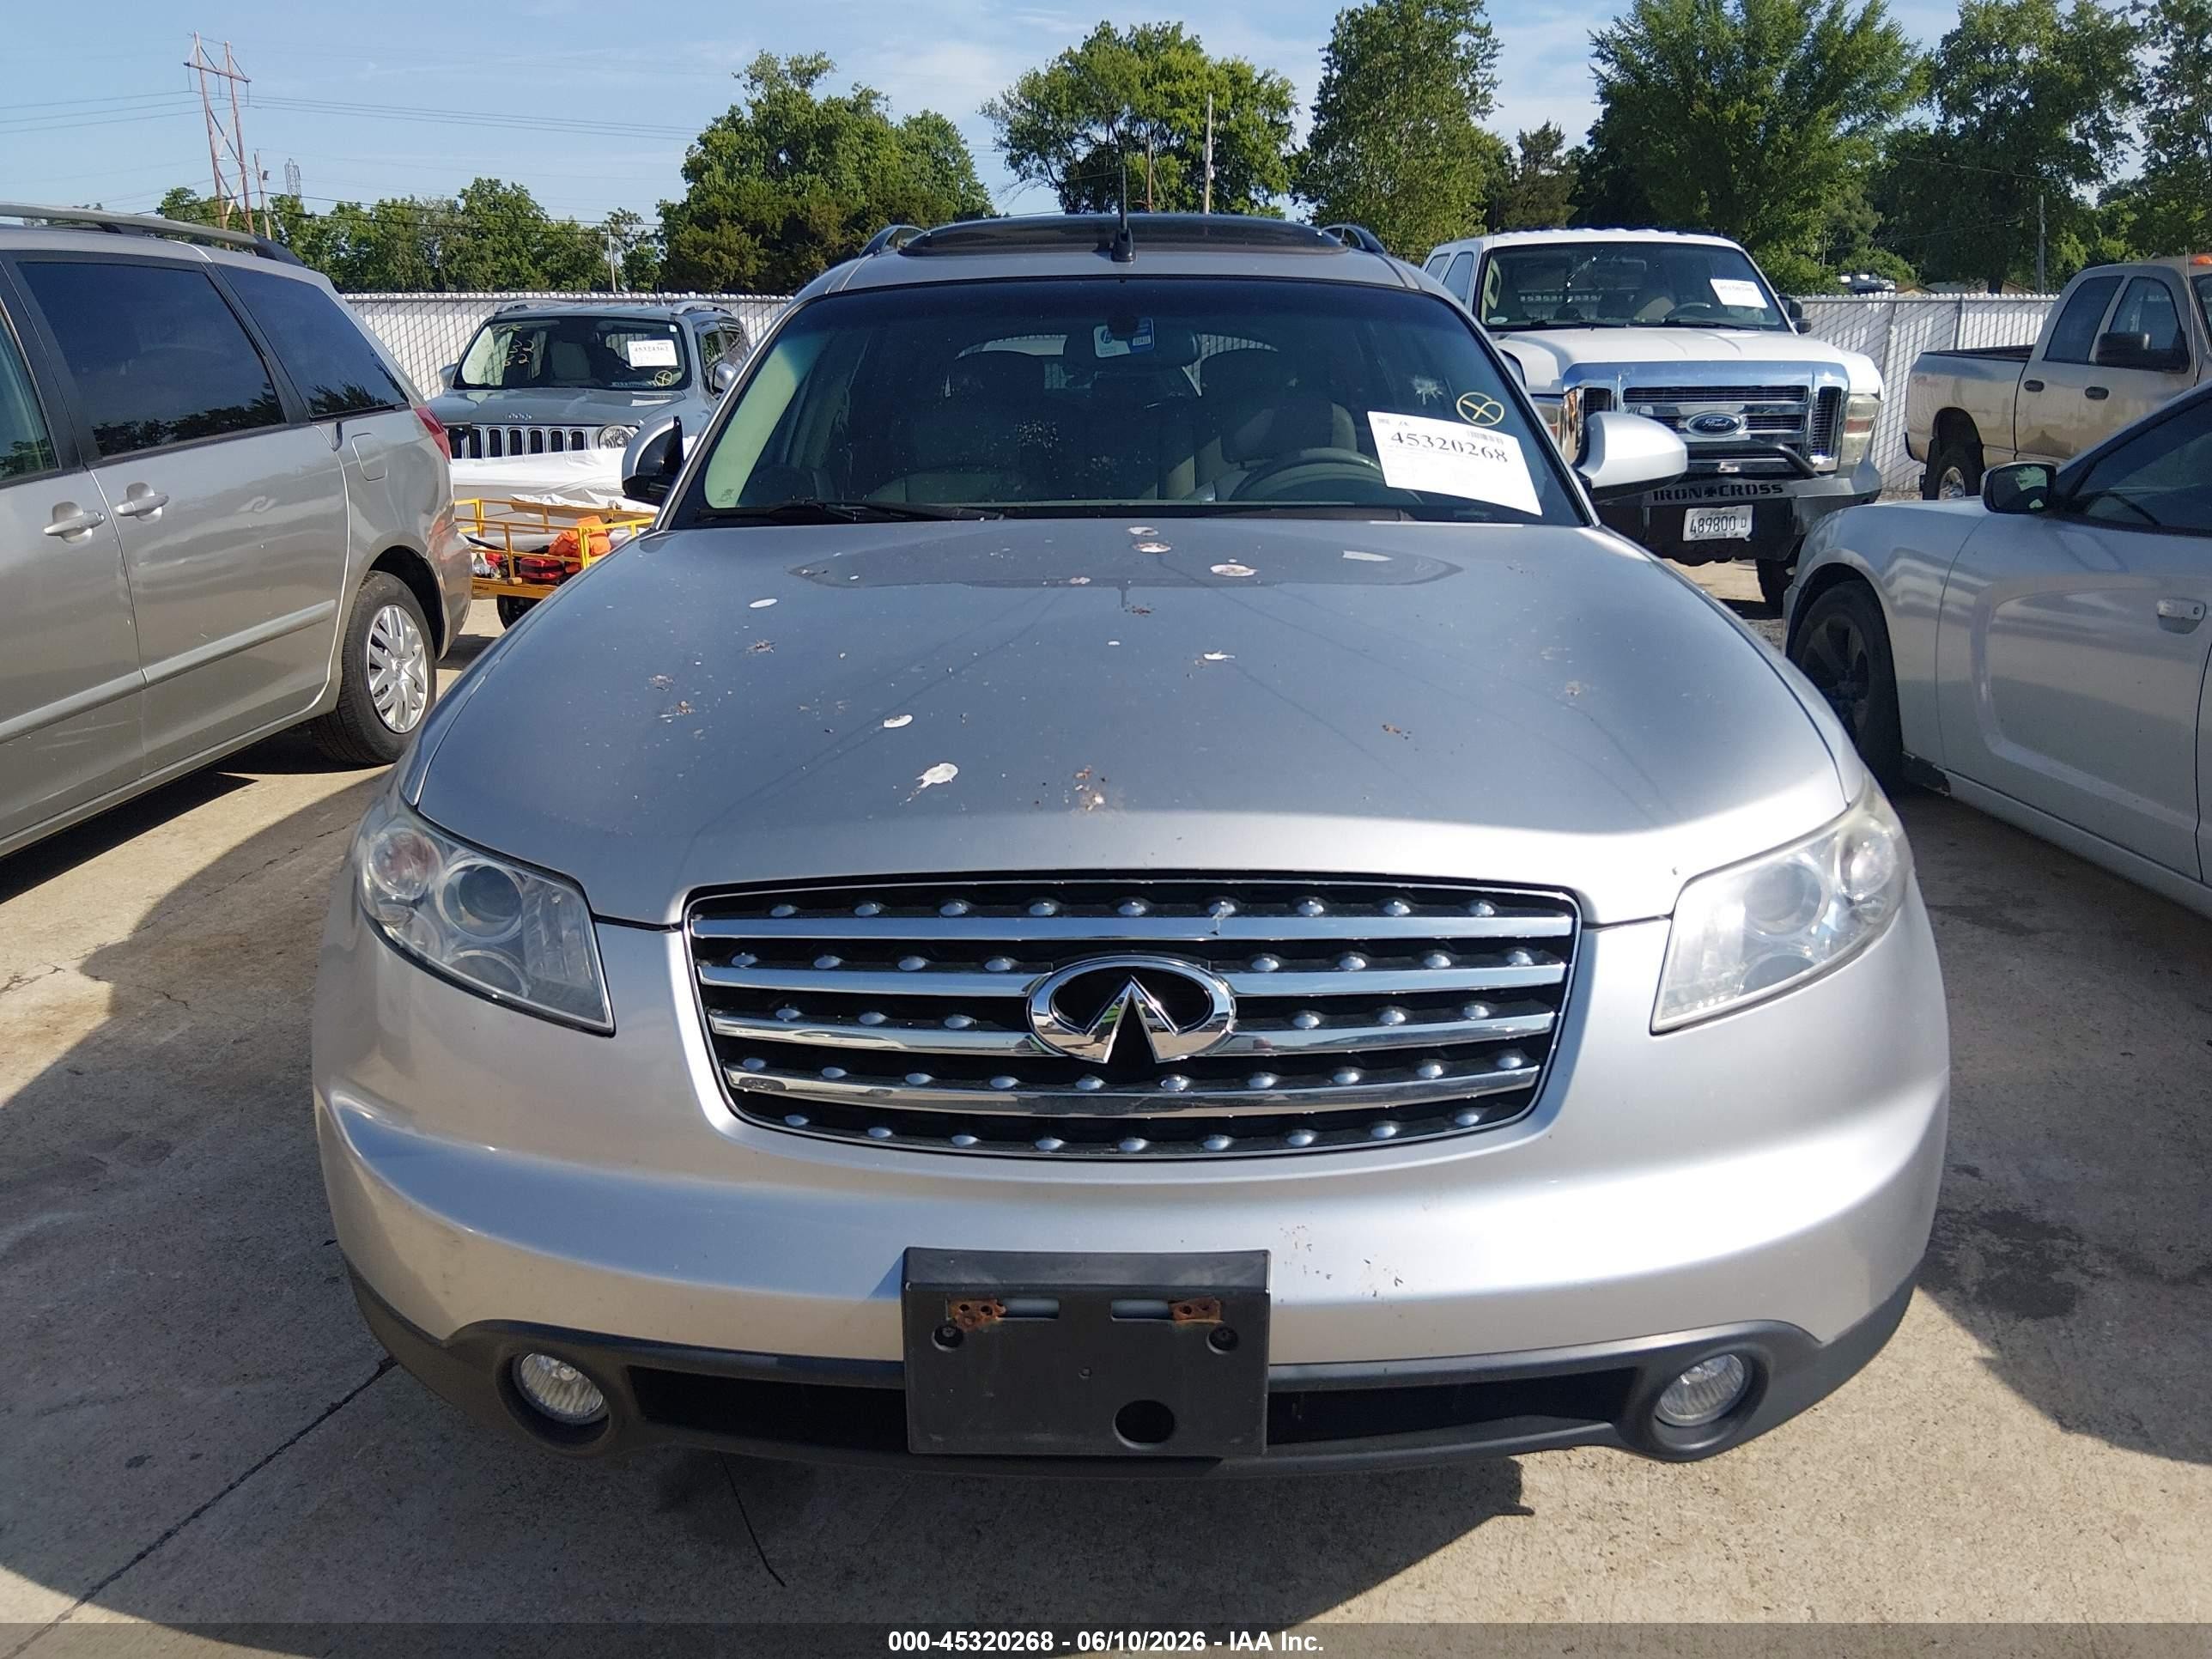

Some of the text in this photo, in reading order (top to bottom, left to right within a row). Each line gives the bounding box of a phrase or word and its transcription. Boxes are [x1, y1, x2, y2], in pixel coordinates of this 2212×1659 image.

[1390, 431, 1508, 463] 45320268
[1653, 483, 1784, 501] IRON CROSS
[1690, 515, 1736, 534] 489800
